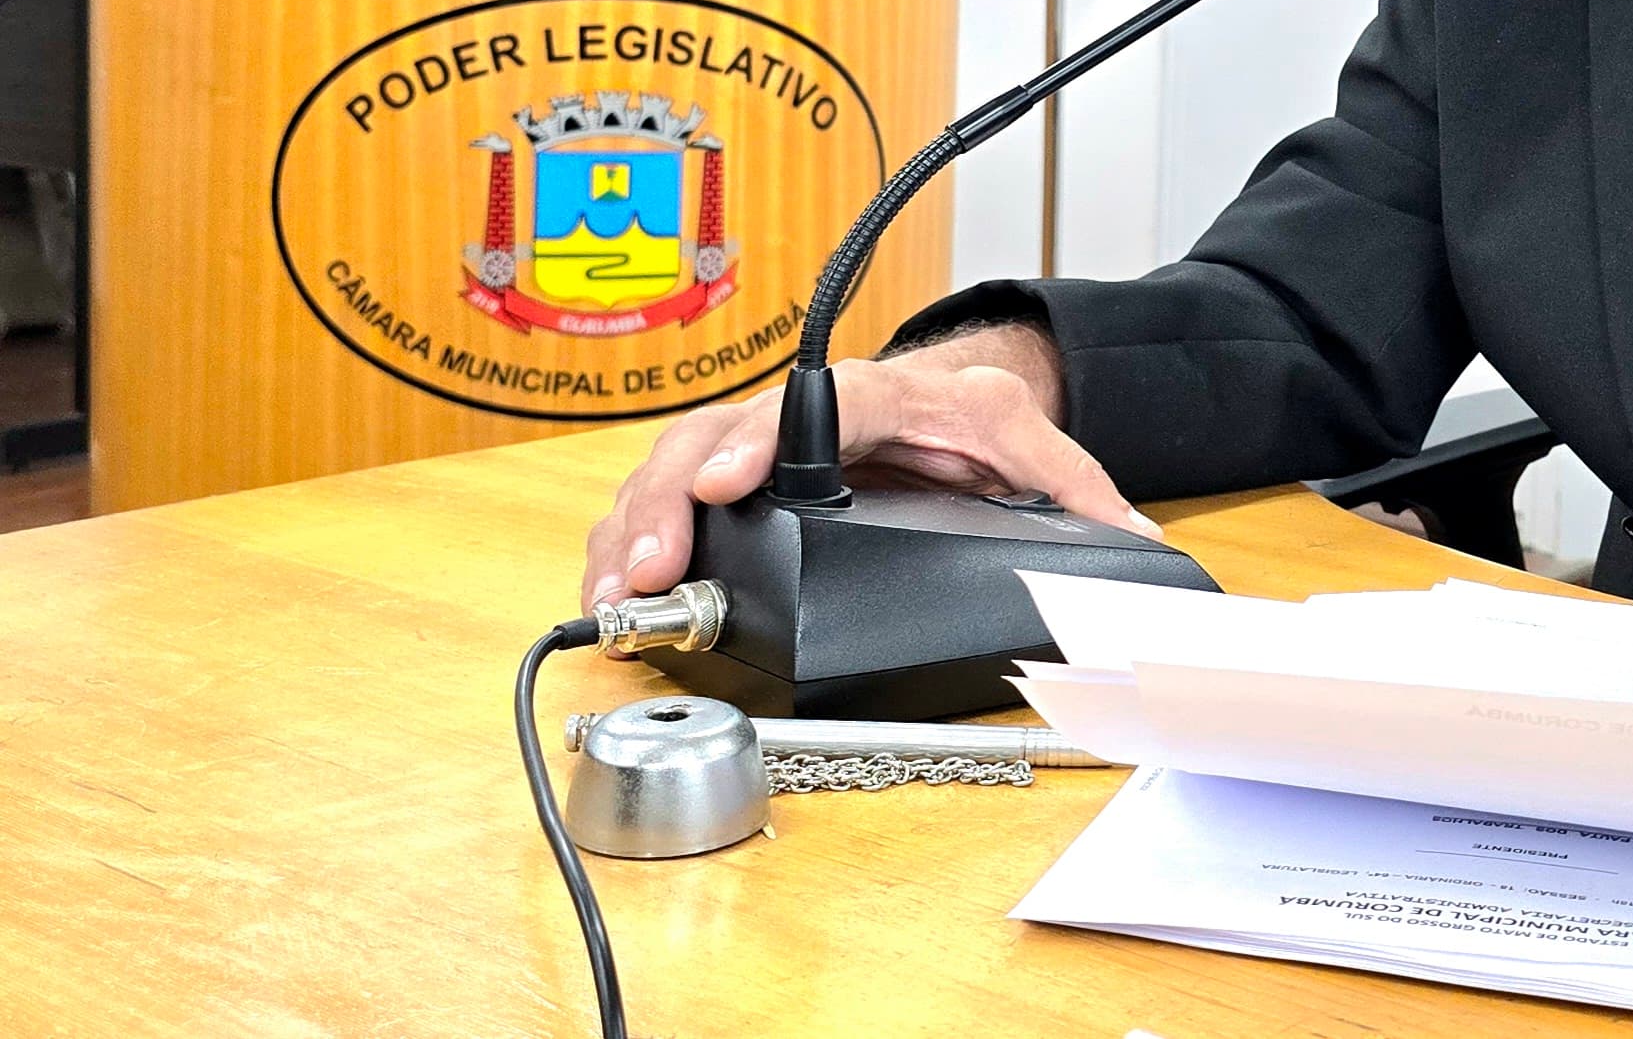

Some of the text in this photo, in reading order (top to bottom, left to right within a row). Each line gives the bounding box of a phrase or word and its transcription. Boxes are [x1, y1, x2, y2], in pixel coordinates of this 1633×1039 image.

[345, 24, 838, 133] PODER LEGISLATIVO
[326, 259, 806, 396] CÂMARA MUNICIPAL DE CORUMBÁ
[1471, 843, 1569, 860] PRESIDENTE
[1278, 896, 1404, 913] CORUMBÁ
[1345, 892, 1513, 913] ADMINISTRATIVA
[1344, 912, 1374, 920] SUL
[1409, 907, 1443, 917] DE
[1406, 919, 1476, 931] GROSSO
[1449, 911, 1589, 934] MUNICIPAL
[1480, 927, 1531, 938] MATO
[1563, 935, 1629, 947] ESTADO
